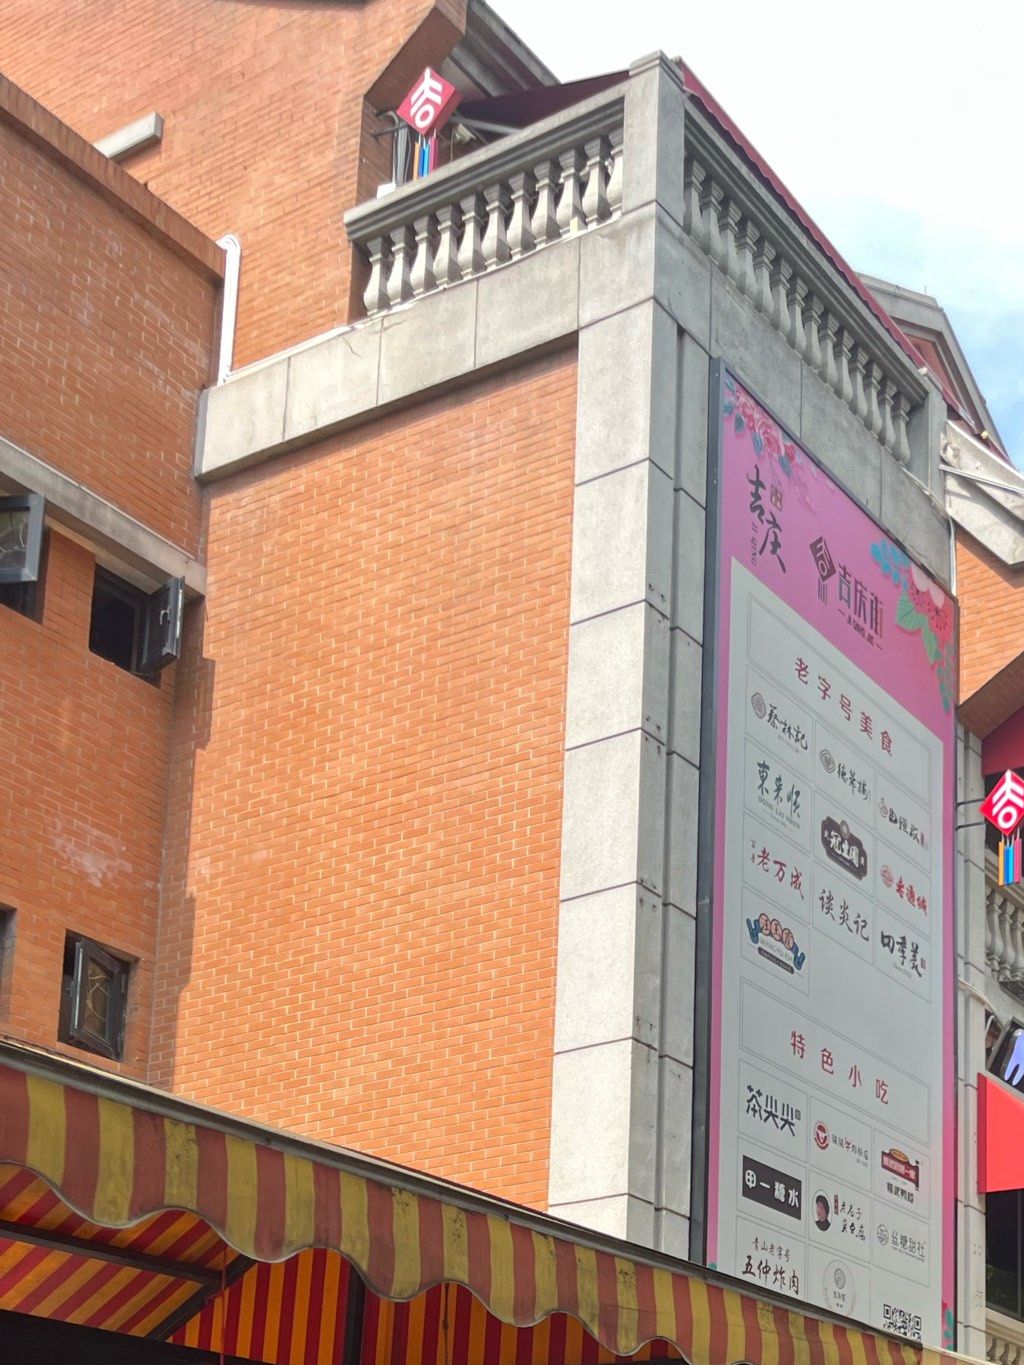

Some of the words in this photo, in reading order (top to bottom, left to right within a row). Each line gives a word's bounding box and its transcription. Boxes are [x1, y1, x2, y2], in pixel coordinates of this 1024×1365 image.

[839, 563, 882, 637] 吉庆街
[795, 658, 892, 756] 老字号美食
[881, 930, 921, 978] 四季美
[791, 1030, 889, 1105] 特色小吃
[745, 1084, 796, 1138] 茶尖尖
